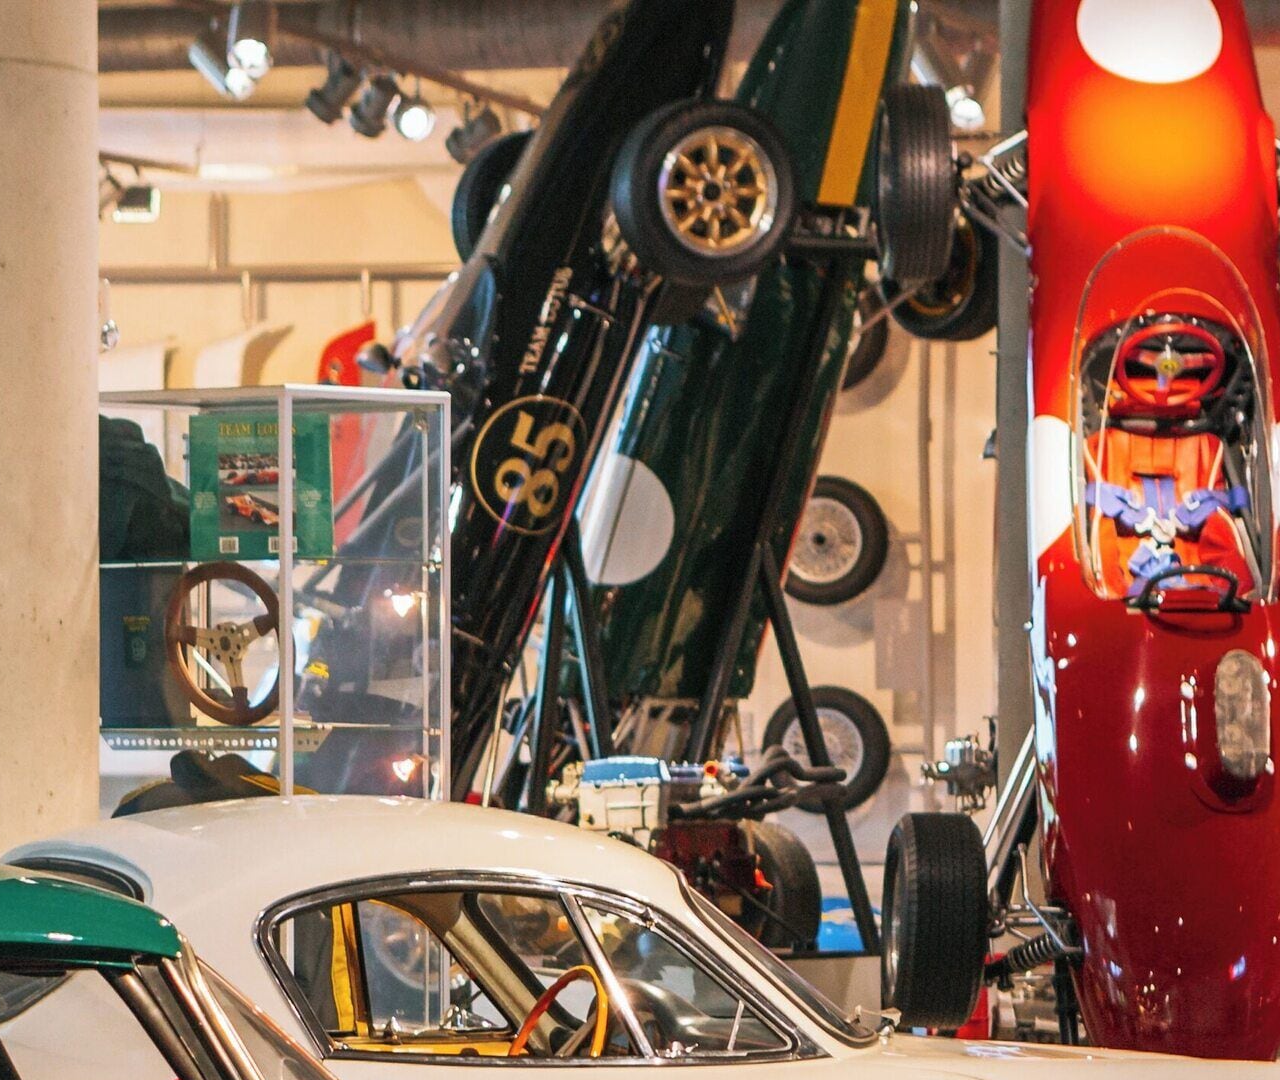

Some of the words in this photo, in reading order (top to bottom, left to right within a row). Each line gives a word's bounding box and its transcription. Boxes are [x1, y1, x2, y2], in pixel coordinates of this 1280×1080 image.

[219, 422, 251, 437] TEAM
[255, 421, 297, 437] LOTS
[494, 409, 576, 518] 85
